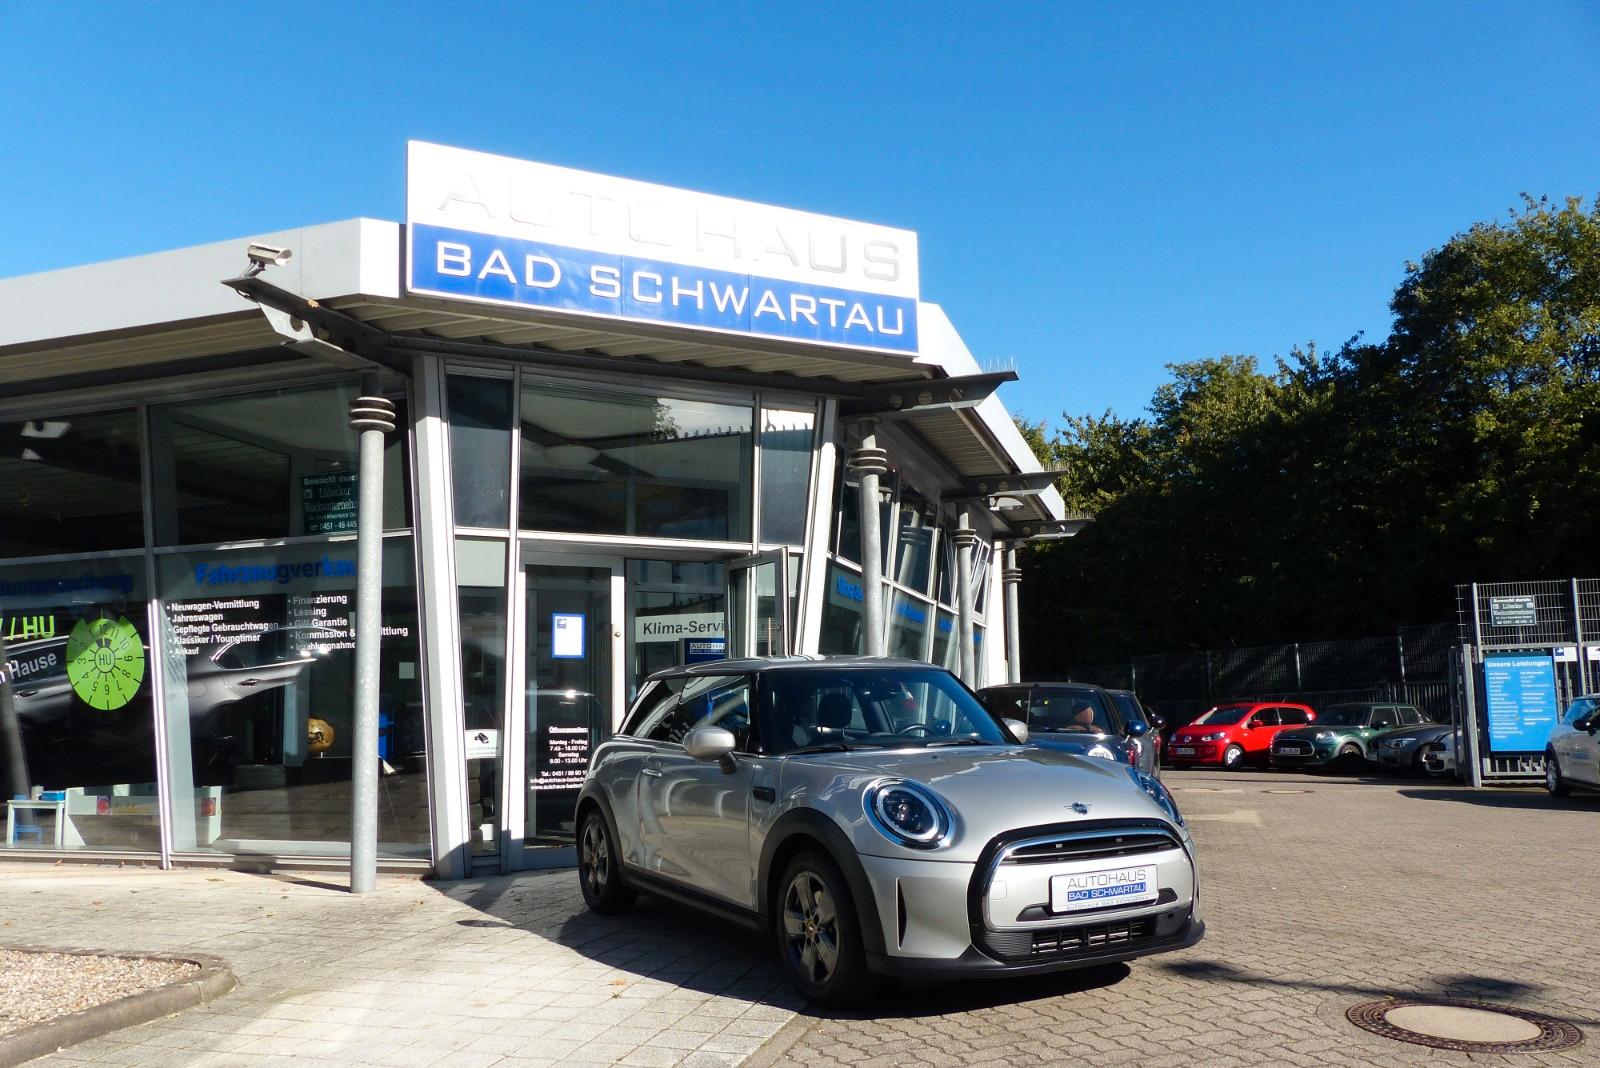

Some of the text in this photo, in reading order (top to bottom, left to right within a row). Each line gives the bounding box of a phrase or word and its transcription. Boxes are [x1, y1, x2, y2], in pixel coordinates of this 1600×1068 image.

[437, 171, 901, 283] AUTOHAUS
[436, 240, 904, 336] BAD SCHWARTAU
[171, 599, 260, 612] Neuwagen-Vermittlung
[292, 595, 348, 605] Finanzierung
[172, 613, 224, 623] Jahreswagen
[293, 607, 327, 617] Leasing
[22, 615, 55, 640] HU
[173, 622, 279, 635] Gepflegte Gebrauchtwagen
[295, 629, 348, 640] Kommission
[380, 626, 409, 637] ittlung
[643, 620, 724, 635] Klima-Servi
[173, 635, 209, 645] Klassiker
[215, 634, 261, 645] Youngtimer
[174, 646, 200, 656] Ankauf
[9, 652, 58, 680] Hause
[77, 657, 87, 665] 3
[99, 654, 112, 666] HU
[121, 669, 131, 679] 8
[1067, 869, 1147, 890] AUTOHAUS
[1068, 882, 1147, 901] BAD SCHWARTAU
